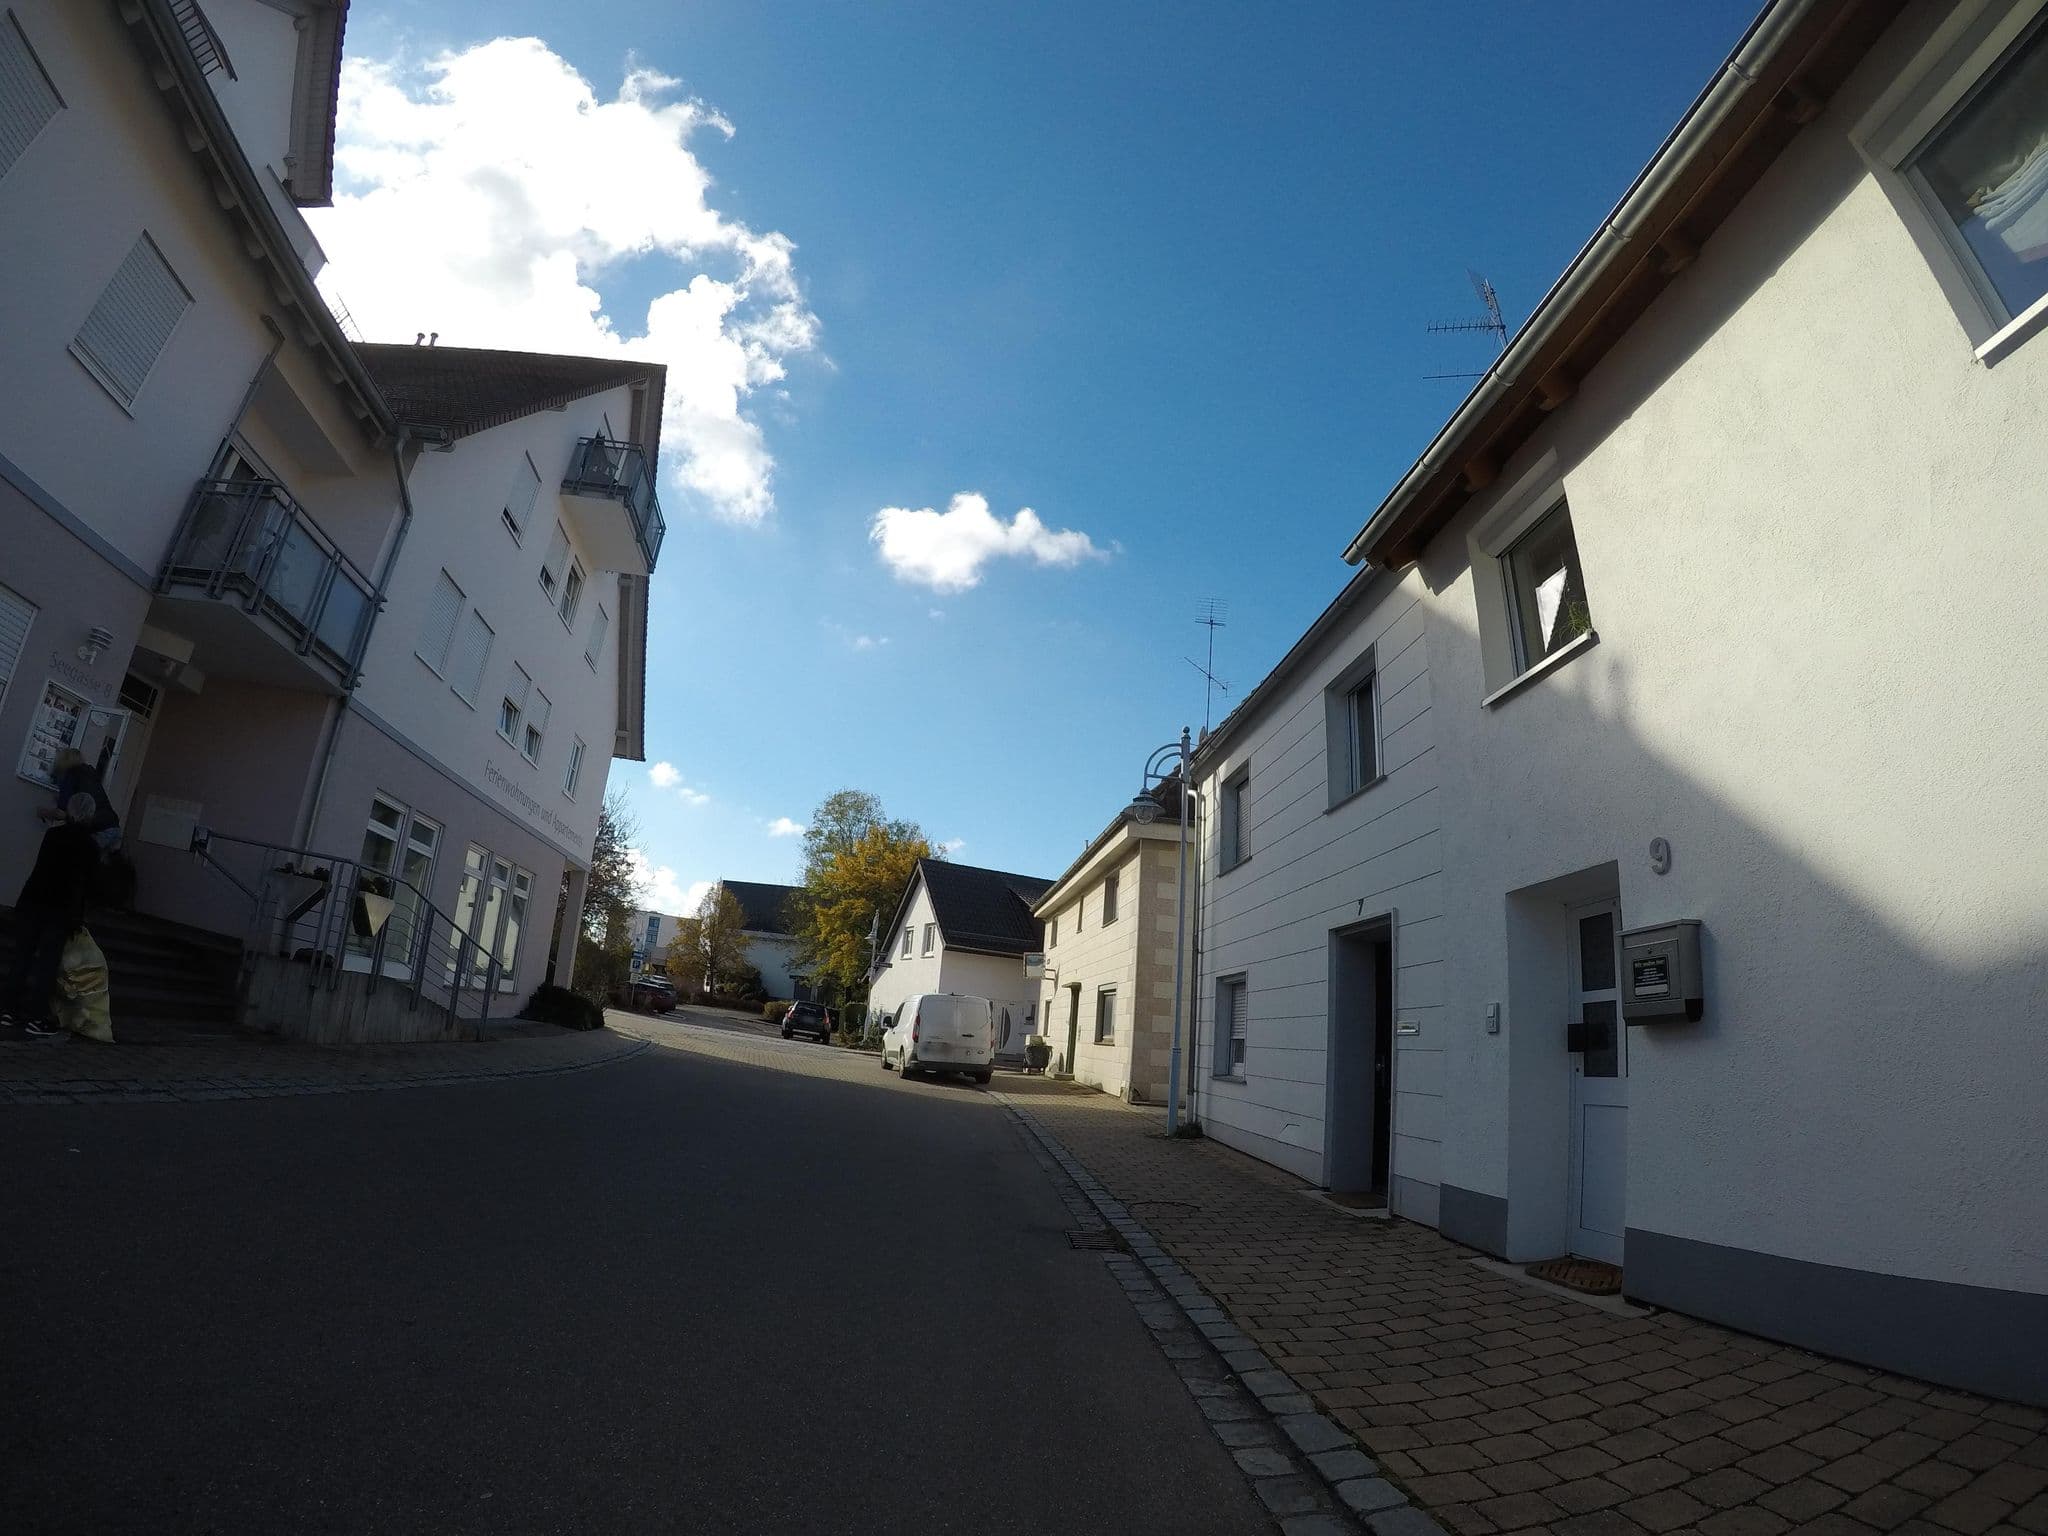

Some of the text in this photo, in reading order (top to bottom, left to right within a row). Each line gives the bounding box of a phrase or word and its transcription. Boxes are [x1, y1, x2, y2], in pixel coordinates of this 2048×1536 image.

[484, 760, 541, 817] Ferienwohnungen
[1649, 837, 1672, 876] 9
[1358, 898, 1364, 916] 7
